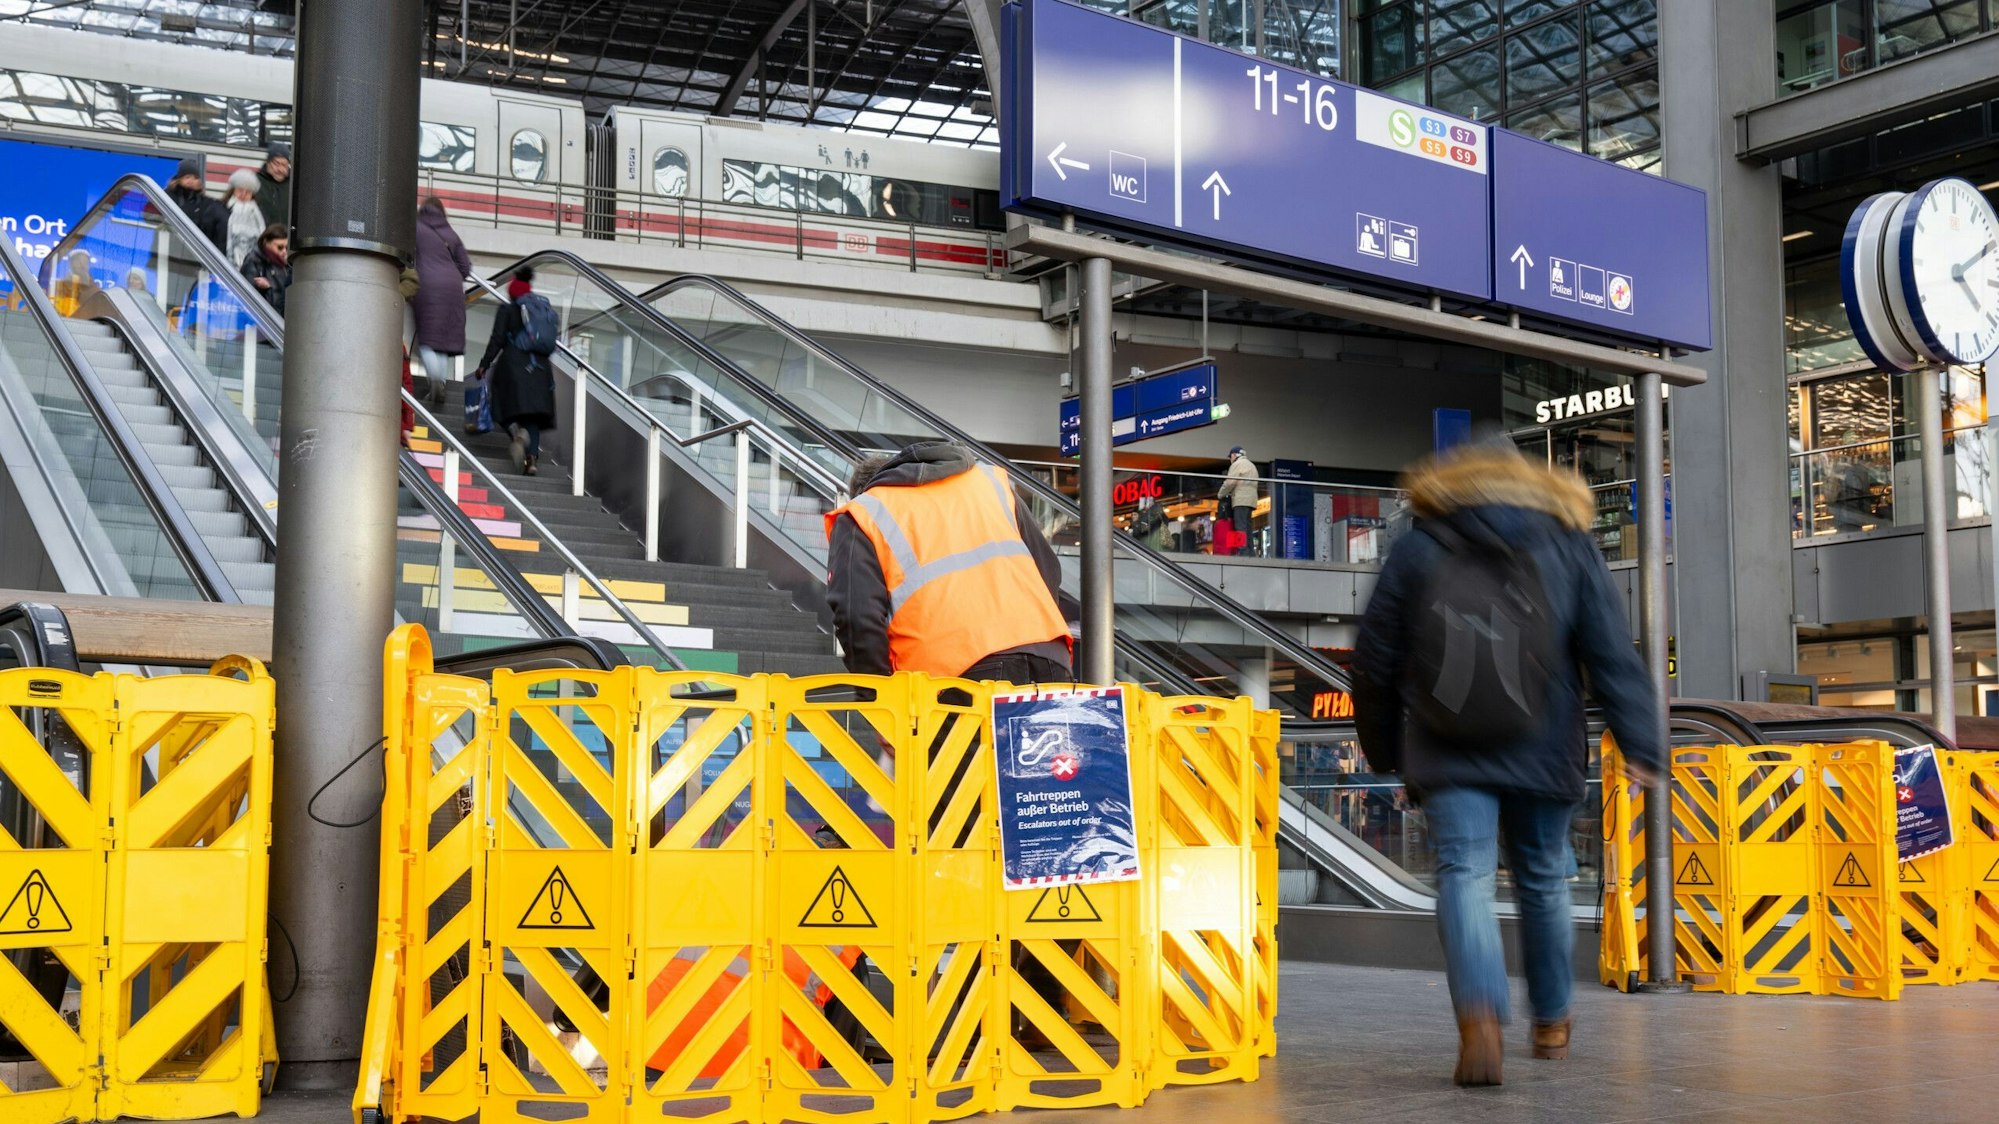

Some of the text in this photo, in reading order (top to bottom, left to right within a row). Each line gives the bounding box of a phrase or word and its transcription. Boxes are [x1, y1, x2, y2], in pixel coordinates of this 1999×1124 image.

[1246, 65, 1338, 131] 11-16
[1392, 112, 1411, 146] S
[1425, 119, 1471, 143] S3 S7
[1425, 140, 1471, 163] S5 S9
[1112, 173, 1138, 195] WC
[24, 214, 67, 237] Ort
[1552, 283, 1573, 296] Polizei
[1581, 289, 1604, 304] Lounge
[1536, 383, 1669, 423] STARBU
[1070, 433, 1081, 447] 11-
[1113, 475, 1163, 505] OBAG
[1016, 790, 1081, 803] Fahrtreppen
[1017, 801, 1089, 817] außer Betrieb
[1897, 806, 1918, 816] reppen
[1900, 811, 1925, 823] Betrieb
[1018, 816, 1102, 830] Escalators out of order
